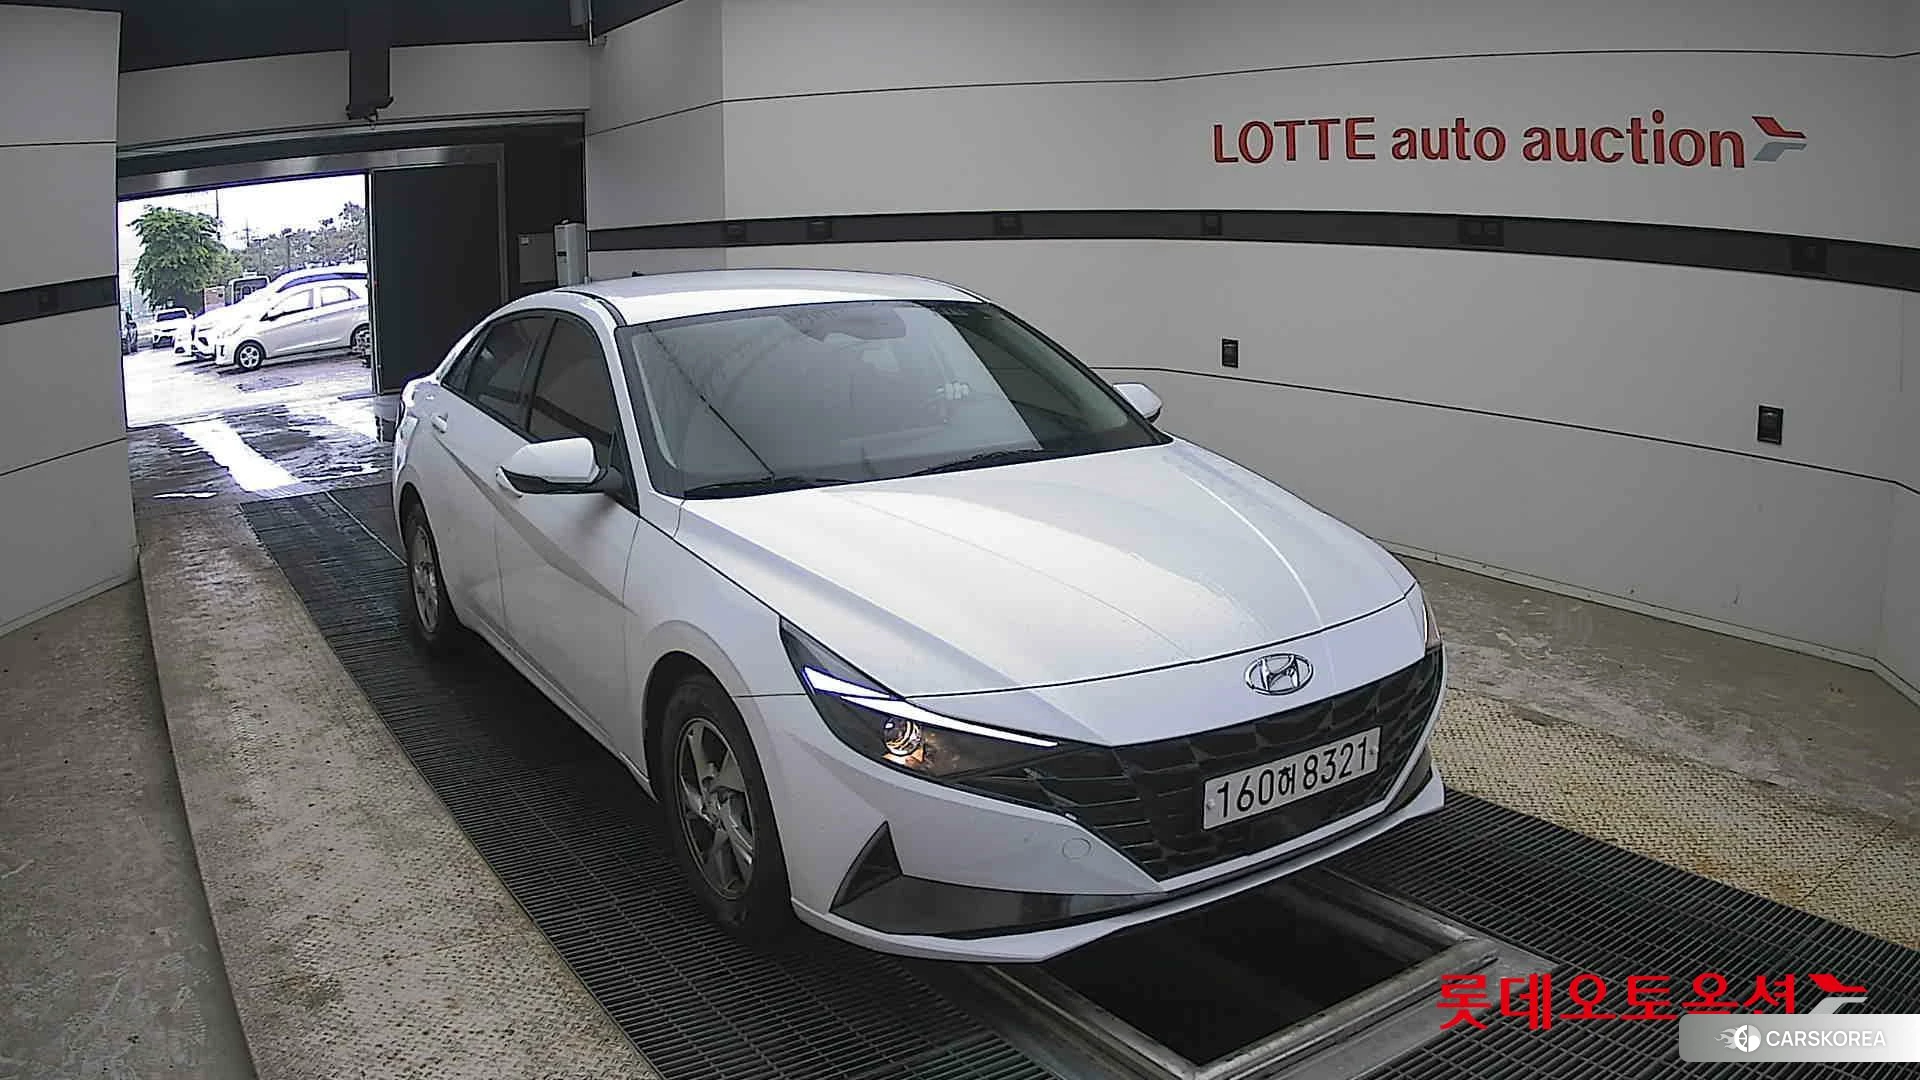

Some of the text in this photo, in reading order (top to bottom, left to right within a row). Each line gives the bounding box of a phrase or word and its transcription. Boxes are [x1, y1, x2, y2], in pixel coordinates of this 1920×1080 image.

[1213, 109, 1745, 169] LOTTE auto auction
